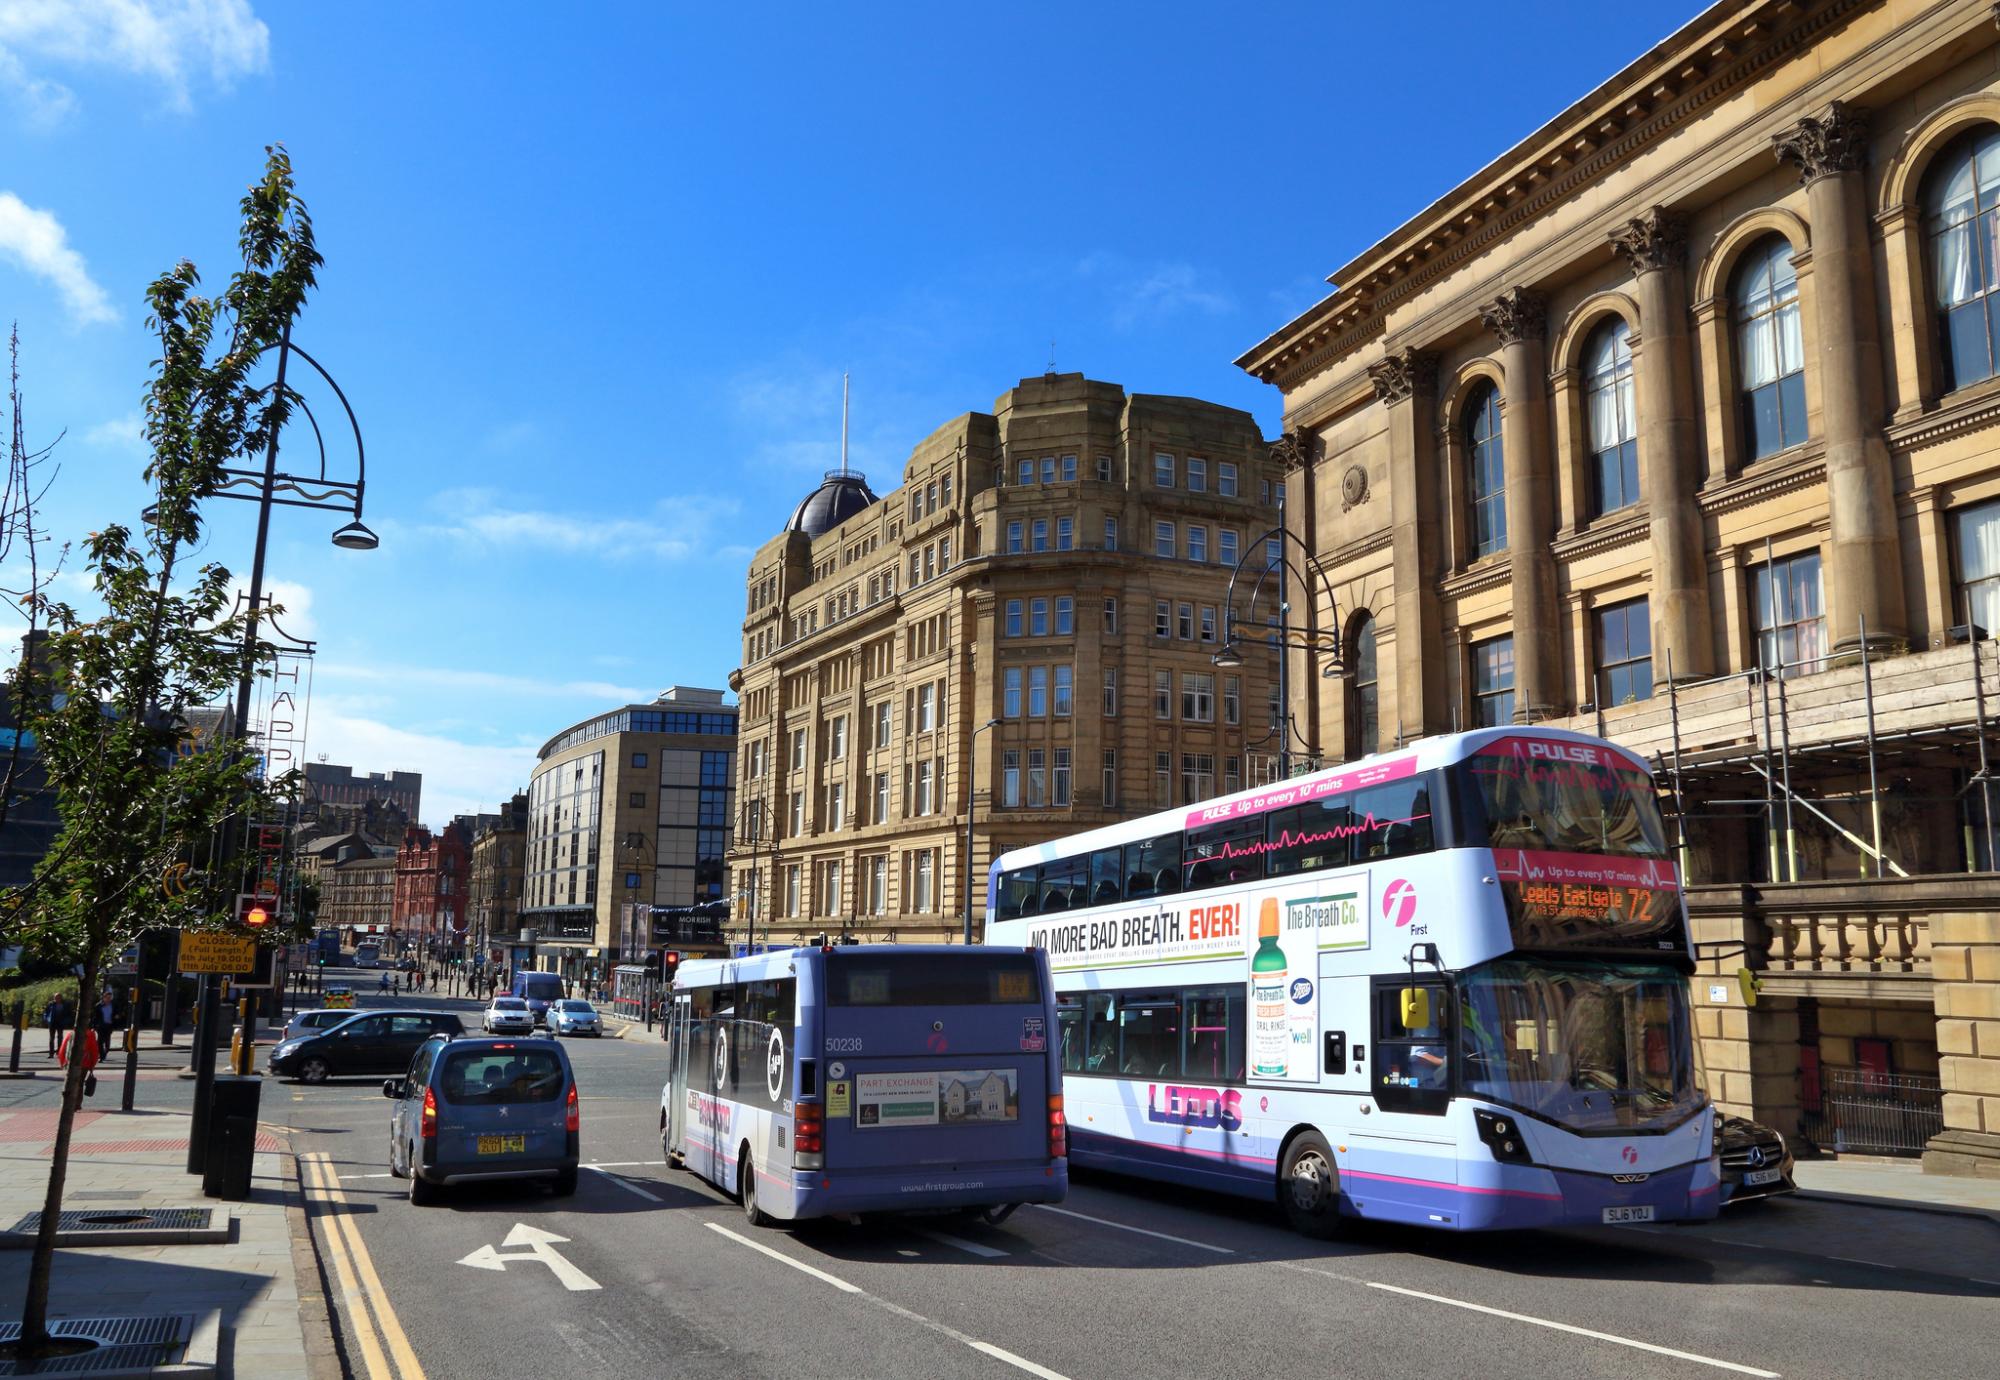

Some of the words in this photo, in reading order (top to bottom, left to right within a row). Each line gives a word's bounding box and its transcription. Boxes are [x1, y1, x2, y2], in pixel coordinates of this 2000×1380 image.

[1527, 742, 1599, 765] PULSE
[1202, 803, 1233, 821] PULSE
[1237, 800, 1252, 814] Up
[1254, 797, 1265, 809] to
[1267, 791, 1297, 806] every
[1316, 778, 1343, 793] mins
[1548, 866, 1563, 879] Up
[1564, 868, 1576, 878] to
[1577, 869, 1602, 881] every
[1616, 871, 1637, 882] mins
[1519, 881, 1560, 905] Leeds
[1562, 884, 1623, 908] Eastgate
[1627, 888, 1654, 922] 72
[1286, 902, 1304, 930] The
[1305, 902, 1340, 929] Breath
[1031, 930, 1048, 949] NO
[1050, 923, 1087, 955] MORE
[1089, 920, 1118, 952] BAD
[1122, 911, 1184, 947] BREATH.
[1188, 902, 1241, 941] EVER!
[1410, 924, 1428, 936] First
[198, 936, 239, 946] CLOSED
[680, 951, 704, 960] UBWAY
[1292, 1028, 1312, 1045] well
[825, 1037, 863, 1052] 50238
[860, 1079, 883, 1089] PART
[886, 1077, 935, 1088] EXCHANGE
[900, 1181, 985, 1192] www.firstgroup.com
[1608, 1208, 1630, 1221] SL16
